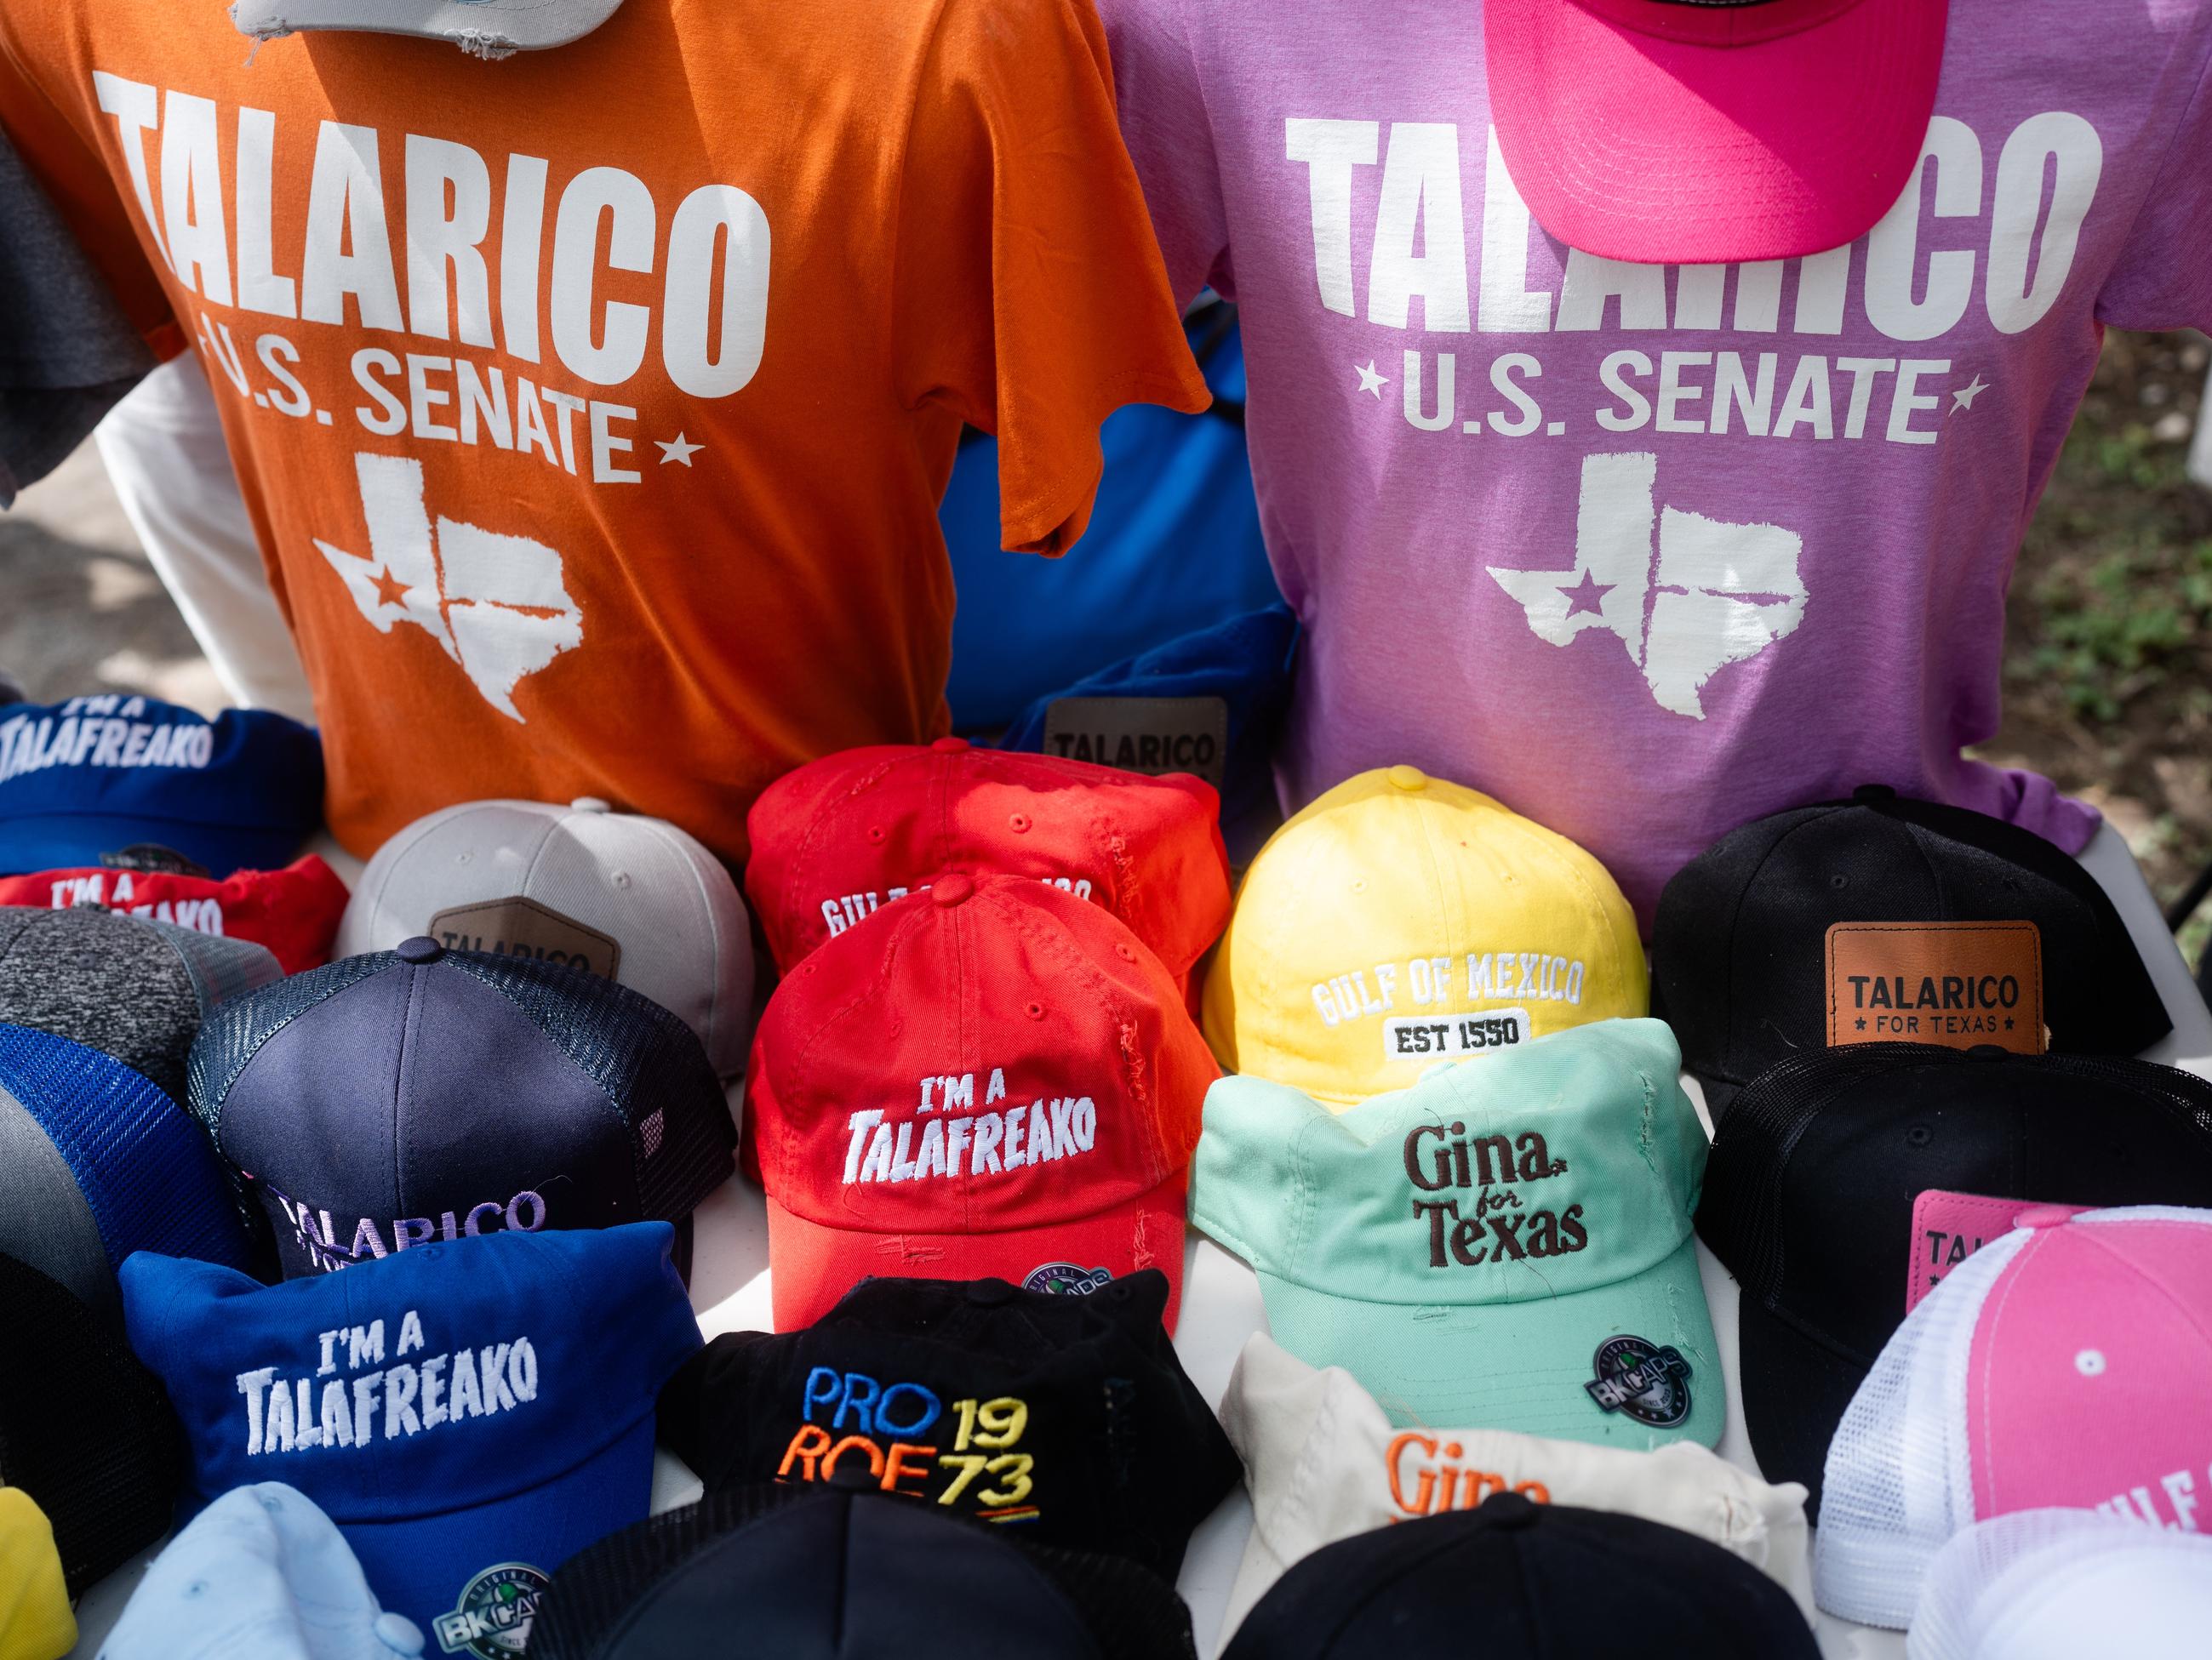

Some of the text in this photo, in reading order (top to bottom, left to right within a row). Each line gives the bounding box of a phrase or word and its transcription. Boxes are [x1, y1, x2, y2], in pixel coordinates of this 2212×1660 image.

[93, 71, 771, 399] TALARICO
[201, 311, 642, 484] U.S. SENATE
[1403, 350, 1952, 444] U.S. SENATE
[120, 695, 146, 718] A
[1054, 733, 1215, 767] TALARICO
[51, 873, 134, 911] I'M A
[1312, 952, 1586, 1027] GULF OF MEXICO
[1848, 975, 2019, 1010] TALARICO
[1395, 1017, 1520, 1053] EST 1550
[1877, 1015, 1997, 1034] FOR TEXAS
[917, 1068, 1005, 1114] I'M A
[842, 1096, 1096, 1184] TALAFREAKO
[1404, 1121, 1554, 1191] Gina
[1476, 1184, 1523, 1219] for
[1413, 1198, 1588, 1268] Texas
[317, 1310, 425, 1377] I'M A
[236, 1336, 538, 1457] TALAFREAKO
[803, 1366, 940, 1438] PRO
[953, 1395, 1028, 1452] 19
[937, 1453, 1034, 1507] 73
